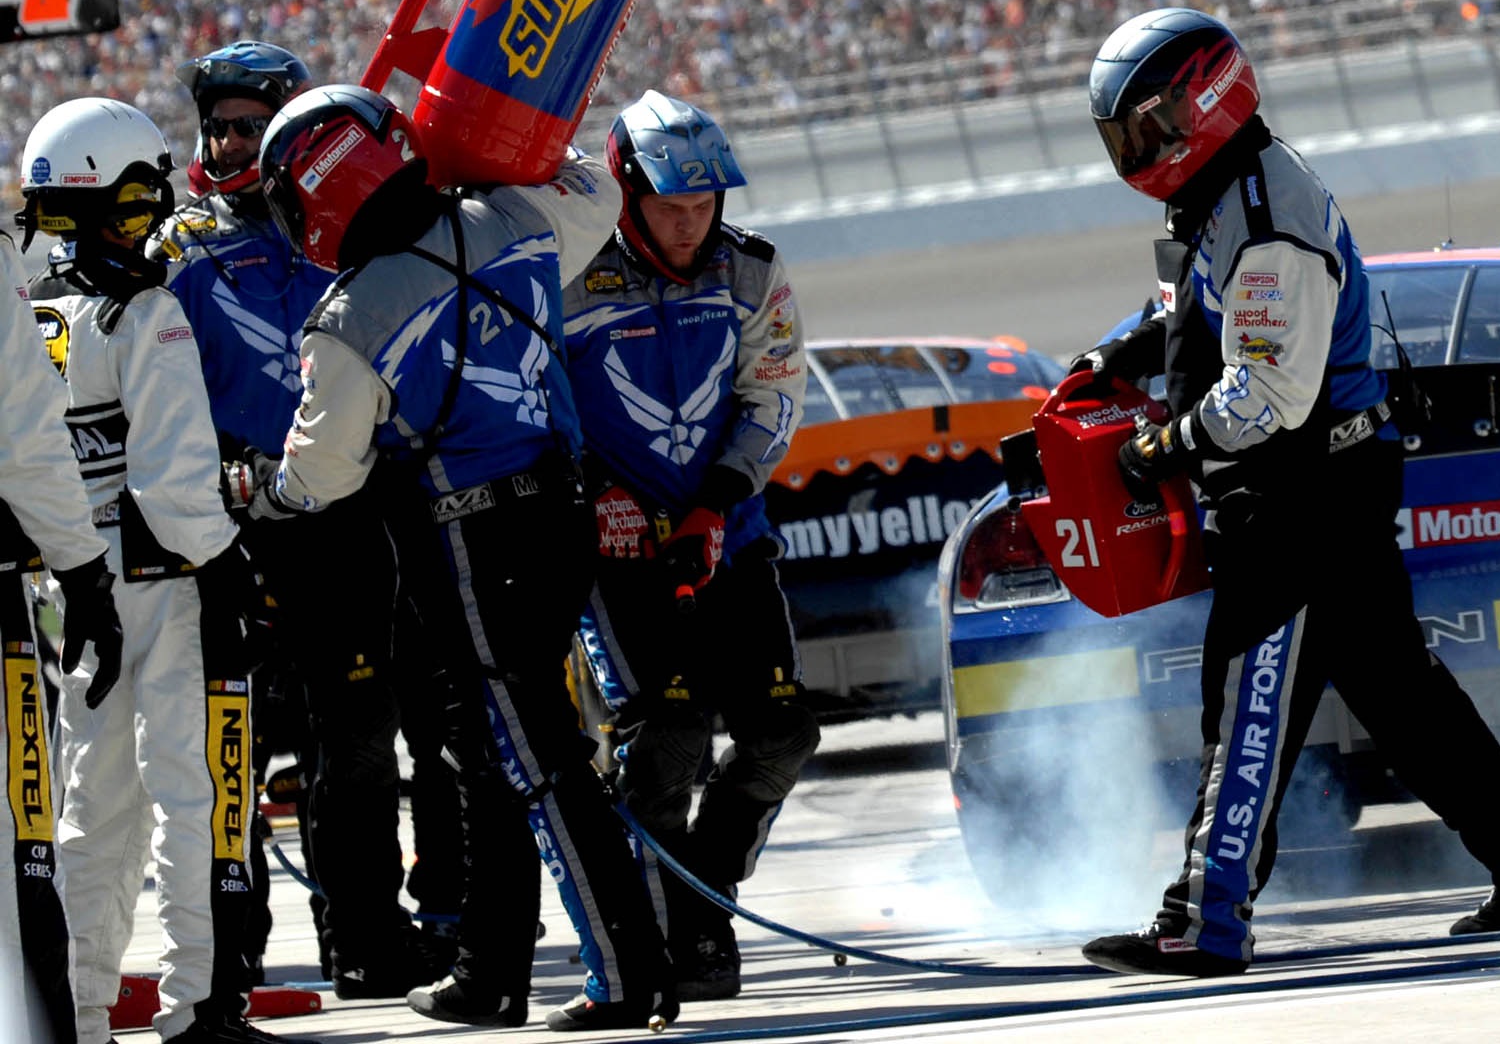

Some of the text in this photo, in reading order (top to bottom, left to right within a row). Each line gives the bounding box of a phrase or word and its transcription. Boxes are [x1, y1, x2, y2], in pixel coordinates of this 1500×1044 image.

[314, 129, 361, 175] Motorcraft
[681, 158, 728, 188] 21
[63, 176, 97, 184] SIMPSON
[1234, 306, 1268, 317] wood
[1055, 518, 1100, 568] 21
[1116, 515, 1170, 536] RACIN
[21, 672, 43, 829] NEXTEL
[1237, 723, 1270, 788] AIR
[220, 708, 242, 849] NEXTEL
[1218, 797, 1257, 861] U.S.
